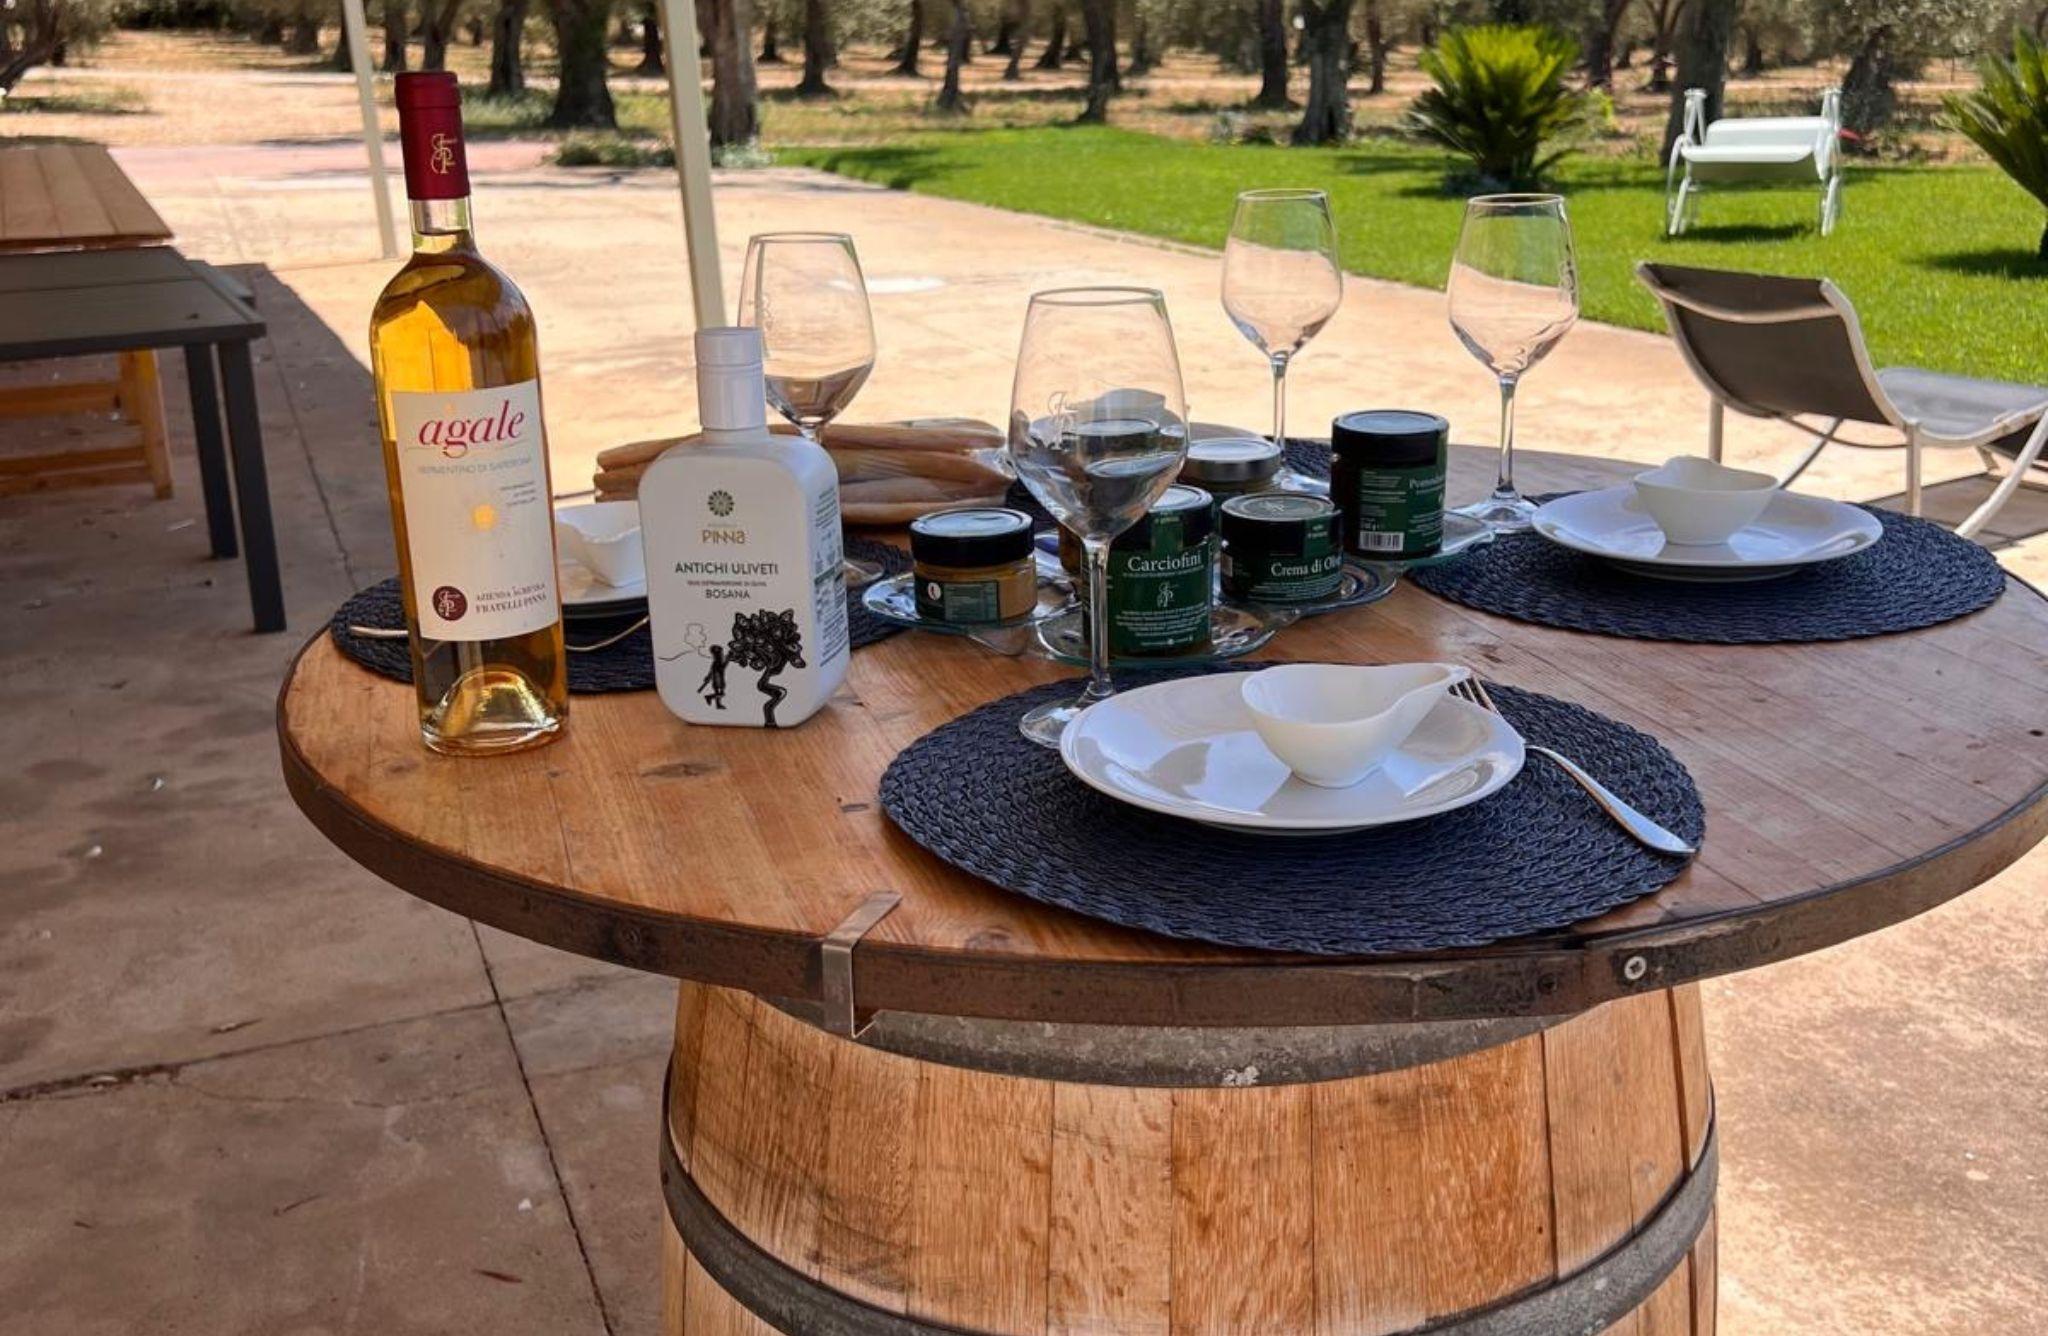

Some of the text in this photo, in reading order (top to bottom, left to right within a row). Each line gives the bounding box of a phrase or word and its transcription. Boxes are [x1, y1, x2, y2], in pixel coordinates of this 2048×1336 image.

[418, 399, 525, 459] agale
[675, 562, 779, 575] ANTICHI ULIVETI
[1127, 550, 1202, 572] Carciofini
[1271, 561, 1309, 577] Crema
[1311, 558, 1322, 573] di
[705, 589, 751, 600] BOSANA
